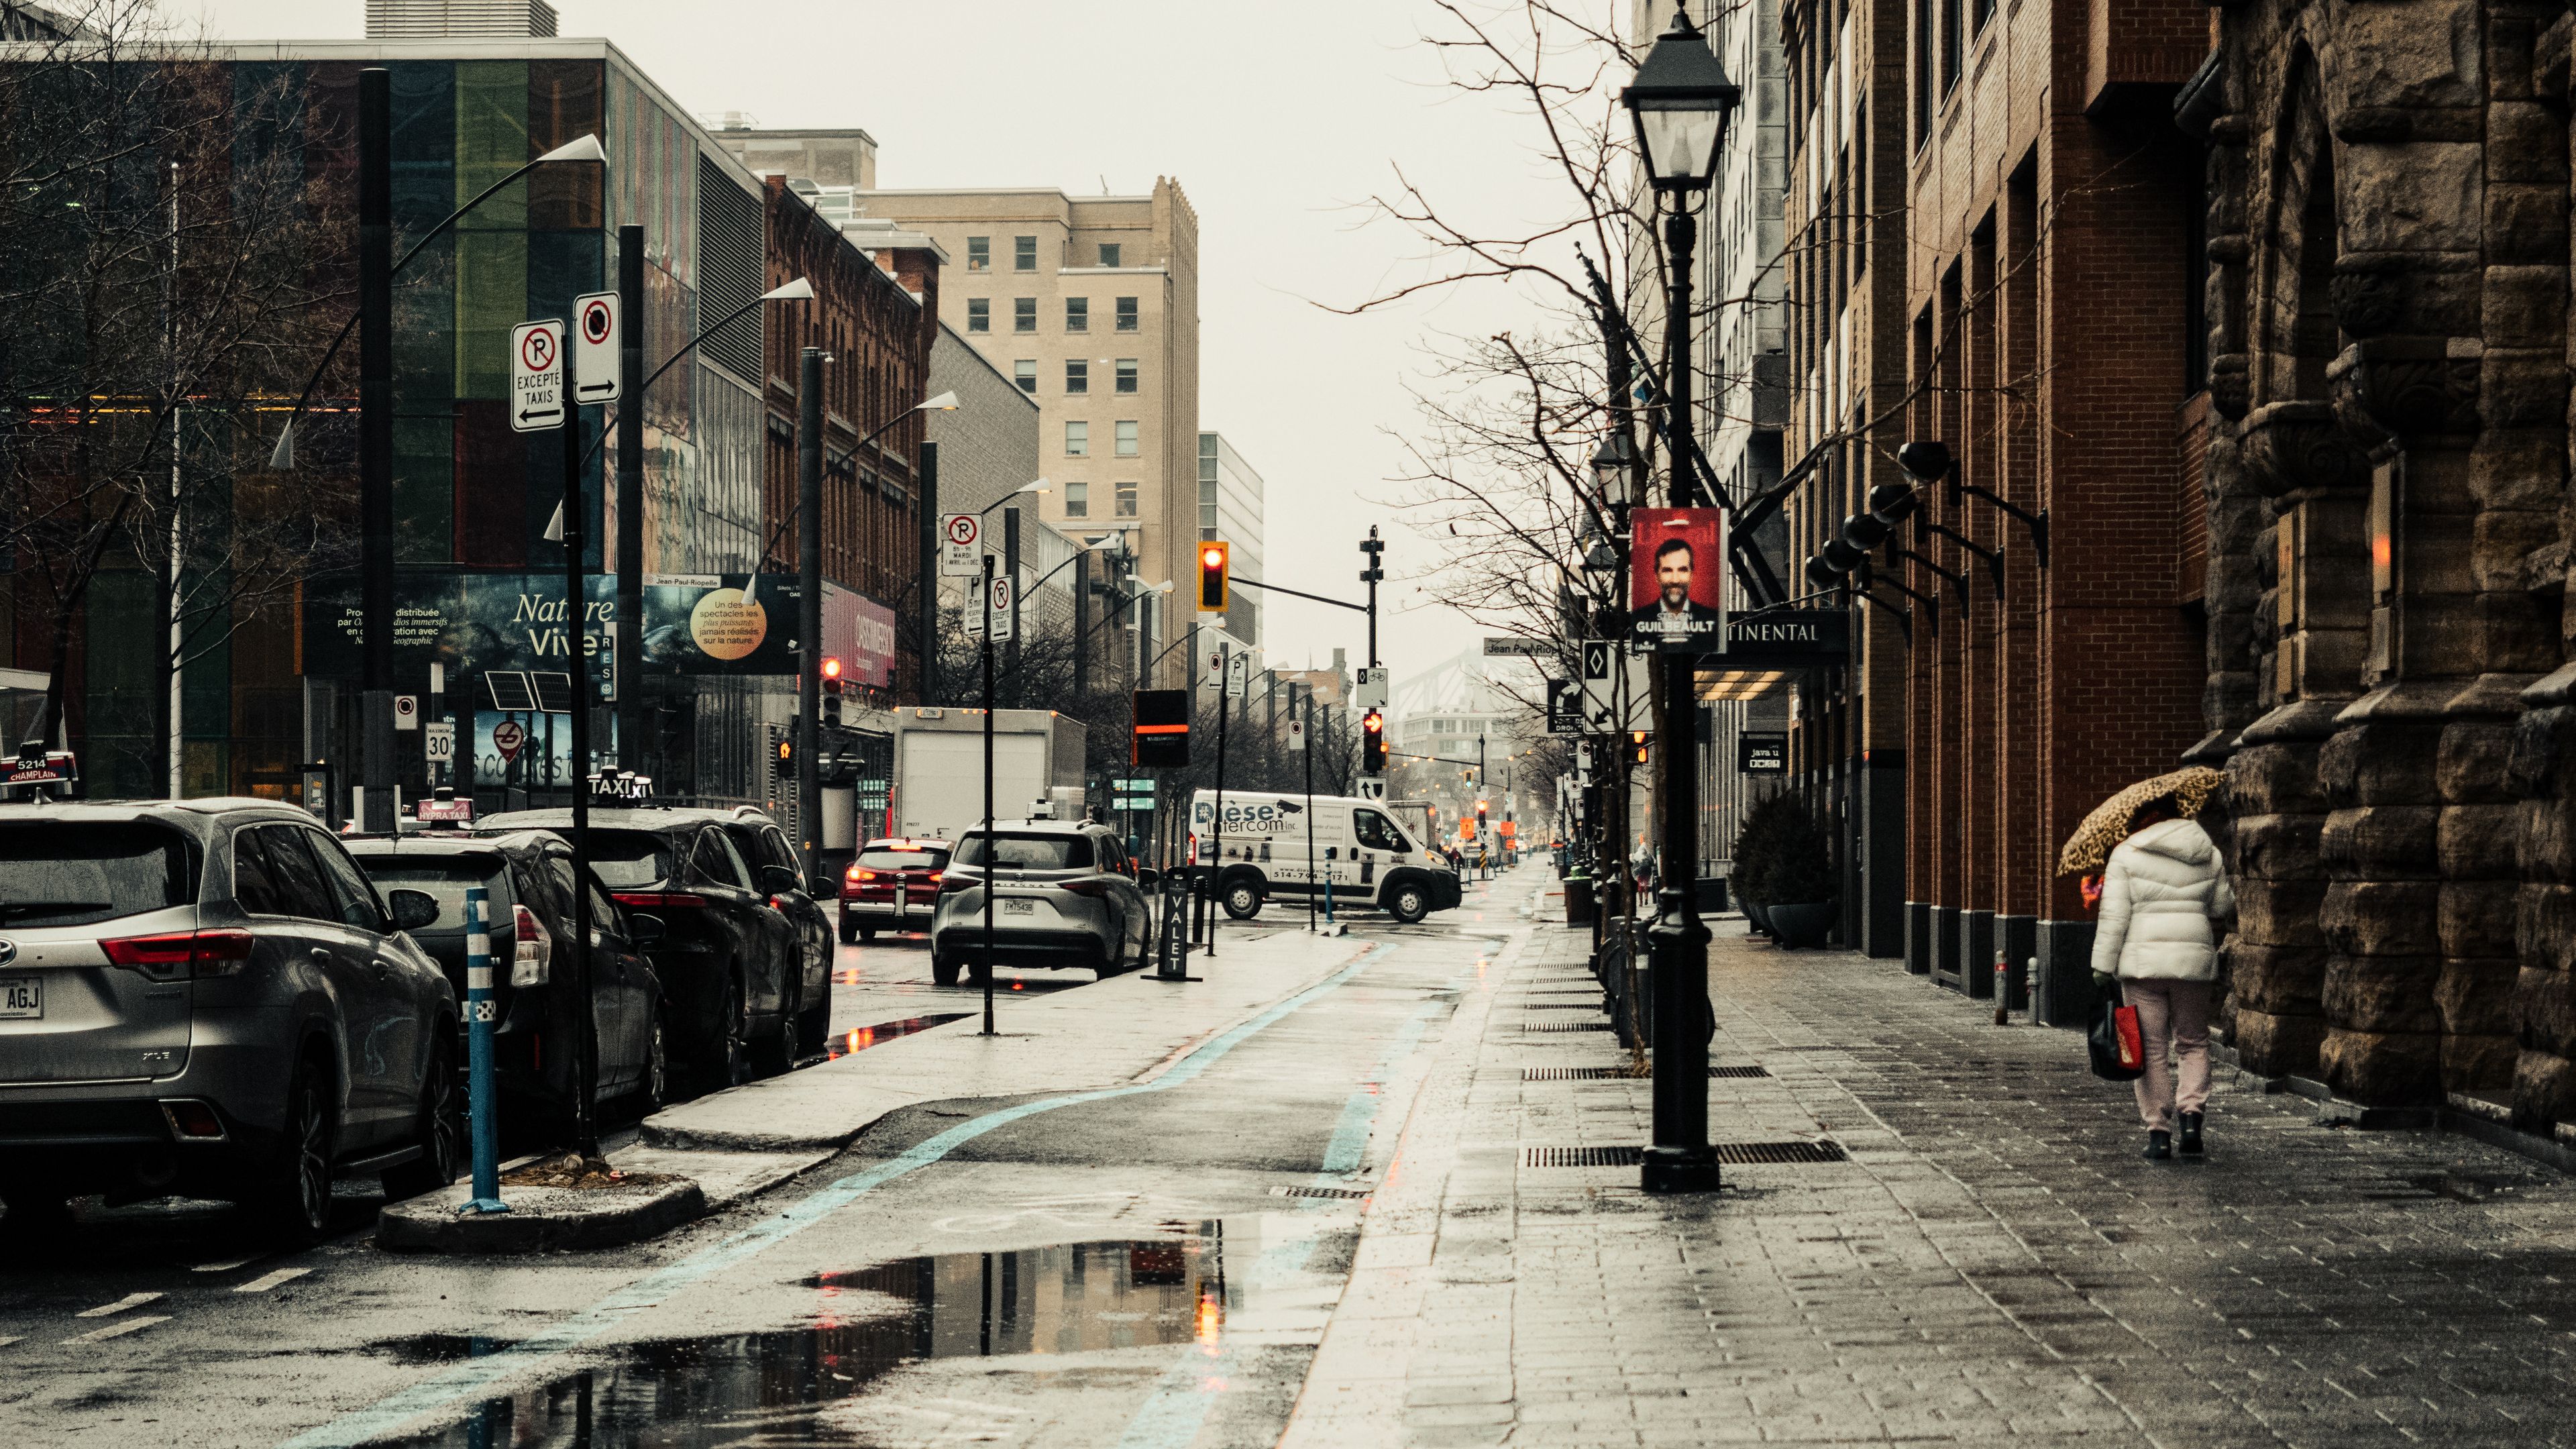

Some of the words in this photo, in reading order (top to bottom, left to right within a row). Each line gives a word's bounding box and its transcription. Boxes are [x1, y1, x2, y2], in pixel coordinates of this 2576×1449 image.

[517, 368, 560, 390] EXCEPTÉ
[525, 390, 553, 405] TAXIS
[395, 608, 439, 616] distribuée
[512, 594, 614, 623] Natre
[699, 610, 744, 619] spectacles
[337, 619, 351, 628] par
[411, 617, 448, 627] immersifs
[703, 619, 719, 628] plus
[720, 619, 755, 628] puissants
[1635, 621, 1715, 633] GUILBEAULT
[699, 628, 726, 637] jamais
[1727, 624, 1819, 641] TINENTAL
[429, 736, 449, 755] 30
[1751, 749, 1771, 758] java
[17, 759, 46, 770] 5214
[10, 770, 56, 781] CHAMPLAIN
[588, 780, 630, 794] TAXI
[449, 812, 469, 820] TAXI
[1195, 800, 1274, 824] Dèse
[1285, 820, 1298, 830] Inc.
[1169, 896, 1183, 971] VALET
[7, 987, 39, 1008] AGJ
